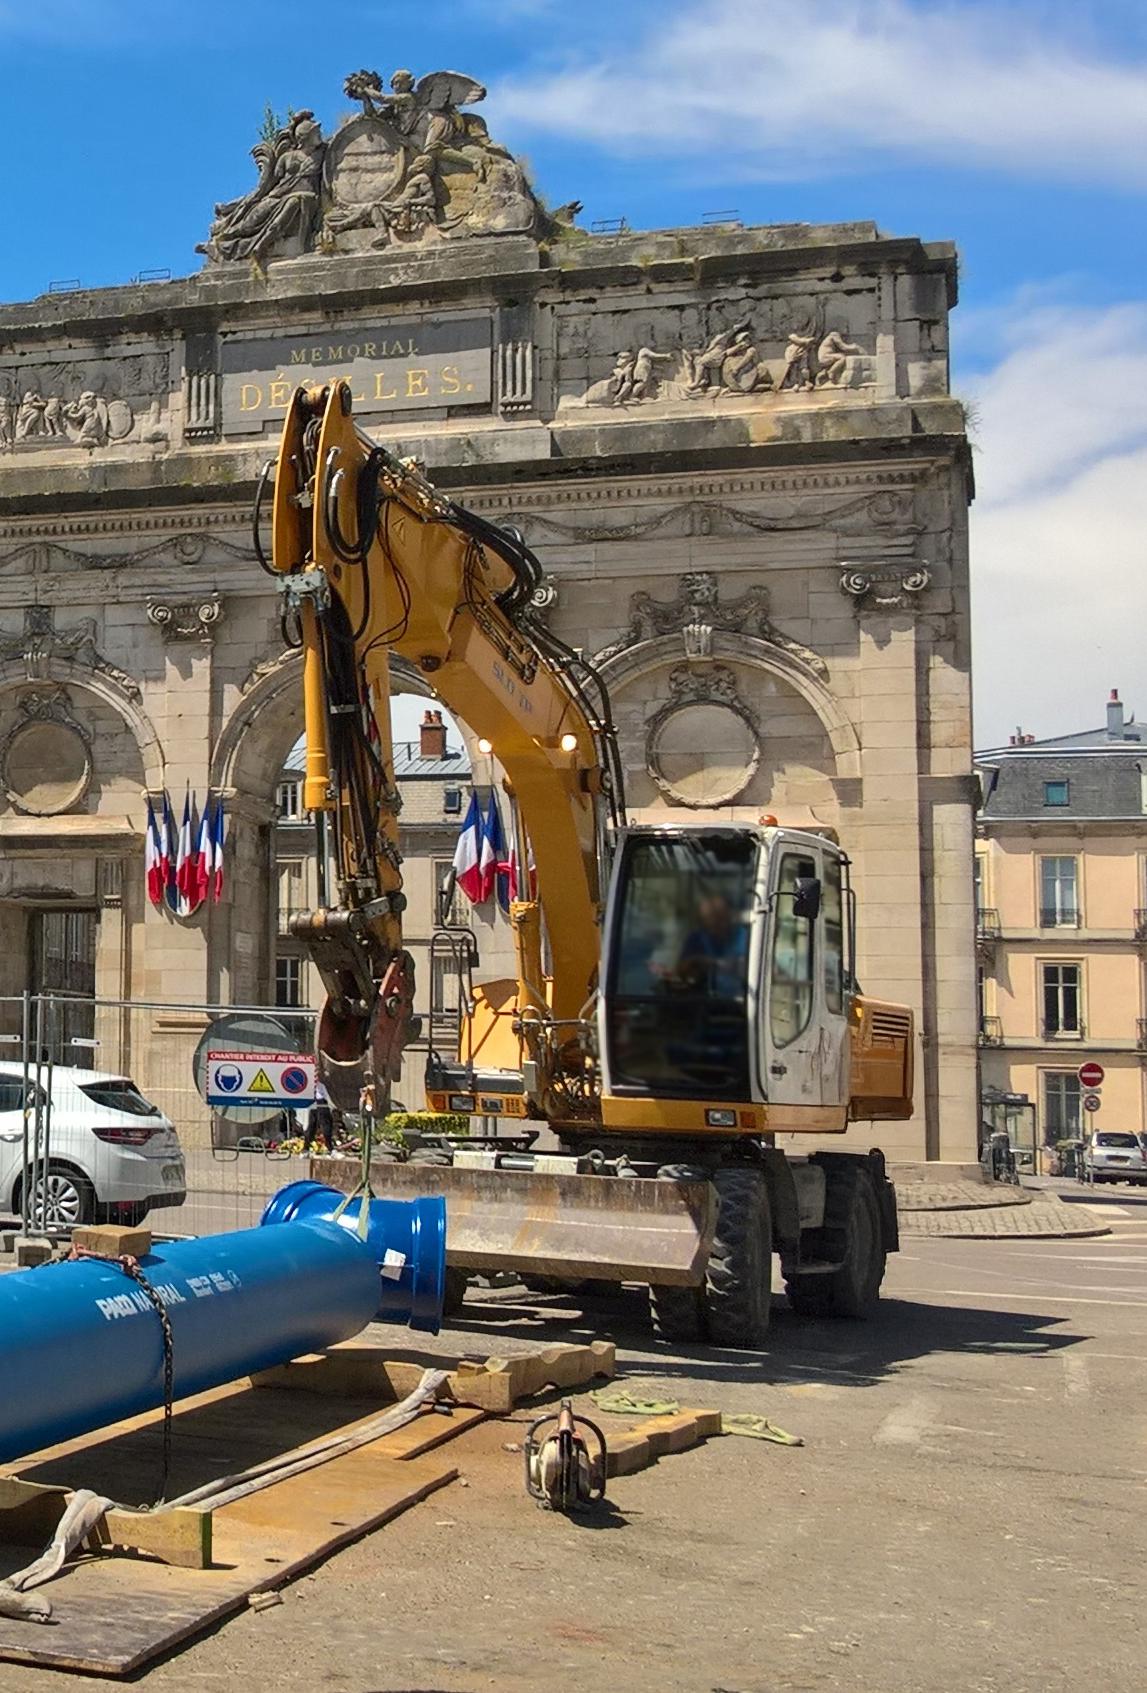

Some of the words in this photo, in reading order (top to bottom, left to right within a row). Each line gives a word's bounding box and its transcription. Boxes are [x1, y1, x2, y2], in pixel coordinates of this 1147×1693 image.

[290, 338, 419, 364] MEMORIAL
[209, 1052, 245, 1061] CHANTIER
[246, 1053, 276, 1062] INTERDIT
[289, 1055, 314, 1063] PUBLIC
